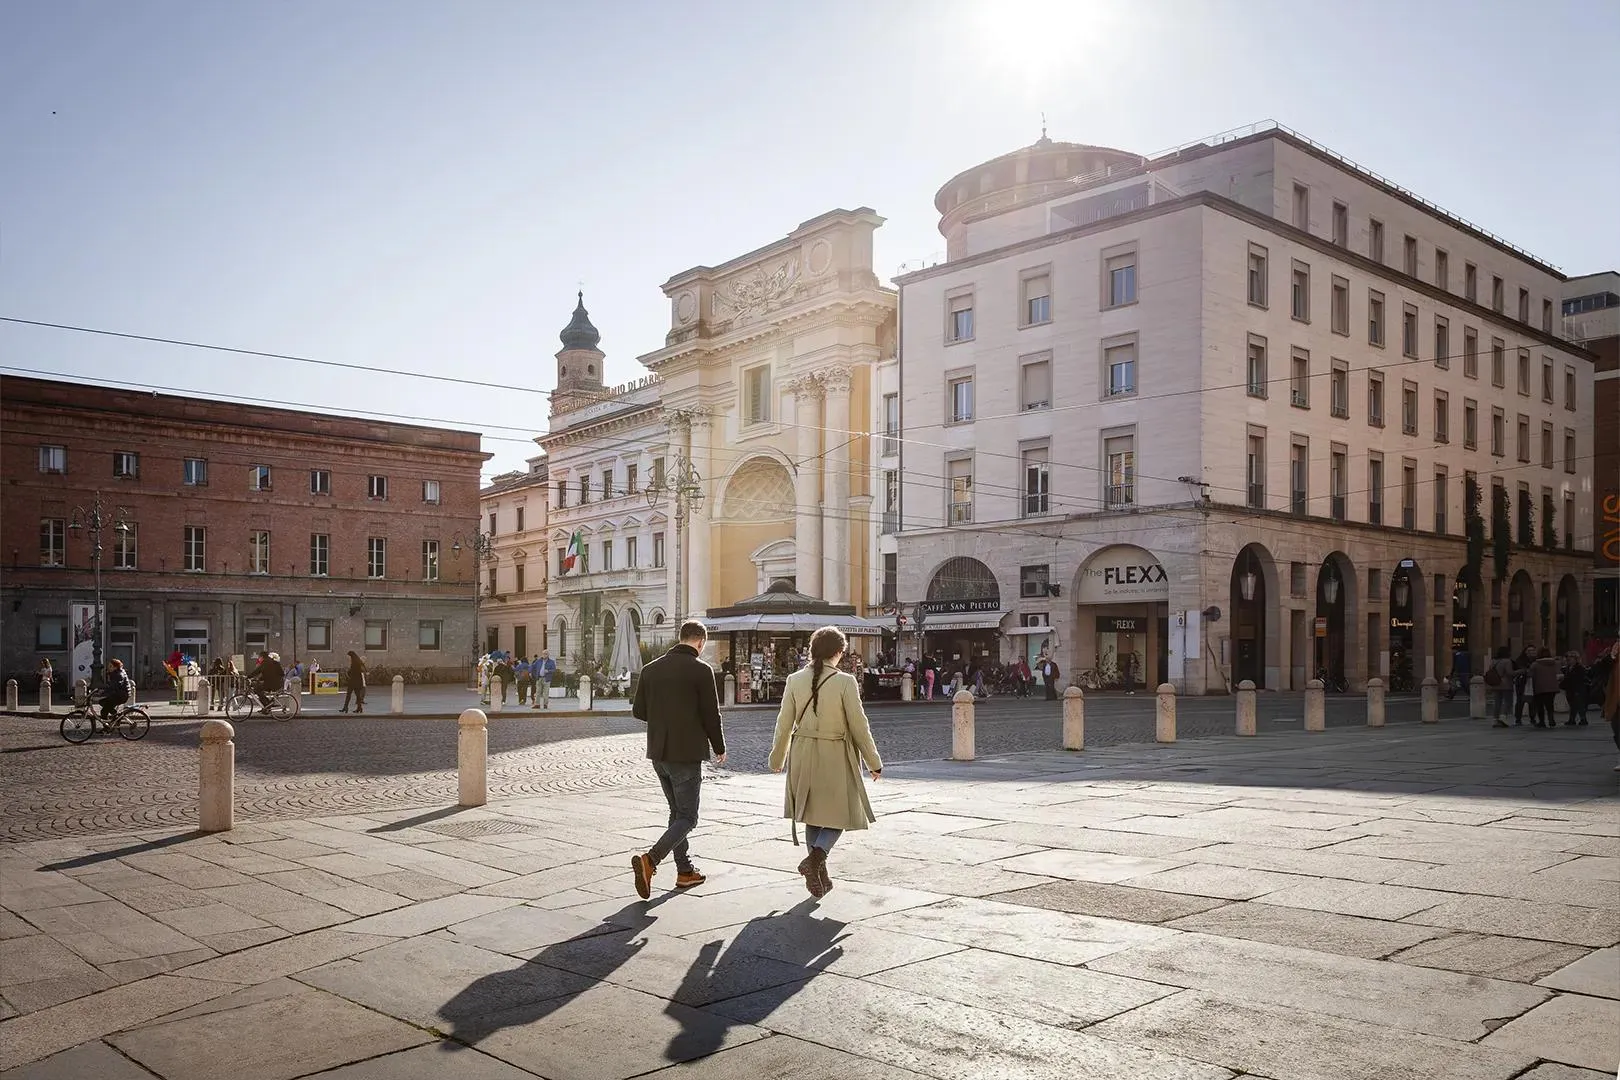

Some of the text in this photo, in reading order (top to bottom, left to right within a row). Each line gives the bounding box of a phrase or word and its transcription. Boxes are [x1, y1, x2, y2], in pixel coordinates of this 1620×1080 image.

[1104, 565, 1168, 585] FLEXX
[950, 602, 966, 611] SAN
[970, 601, 998, 610] PIETRO
